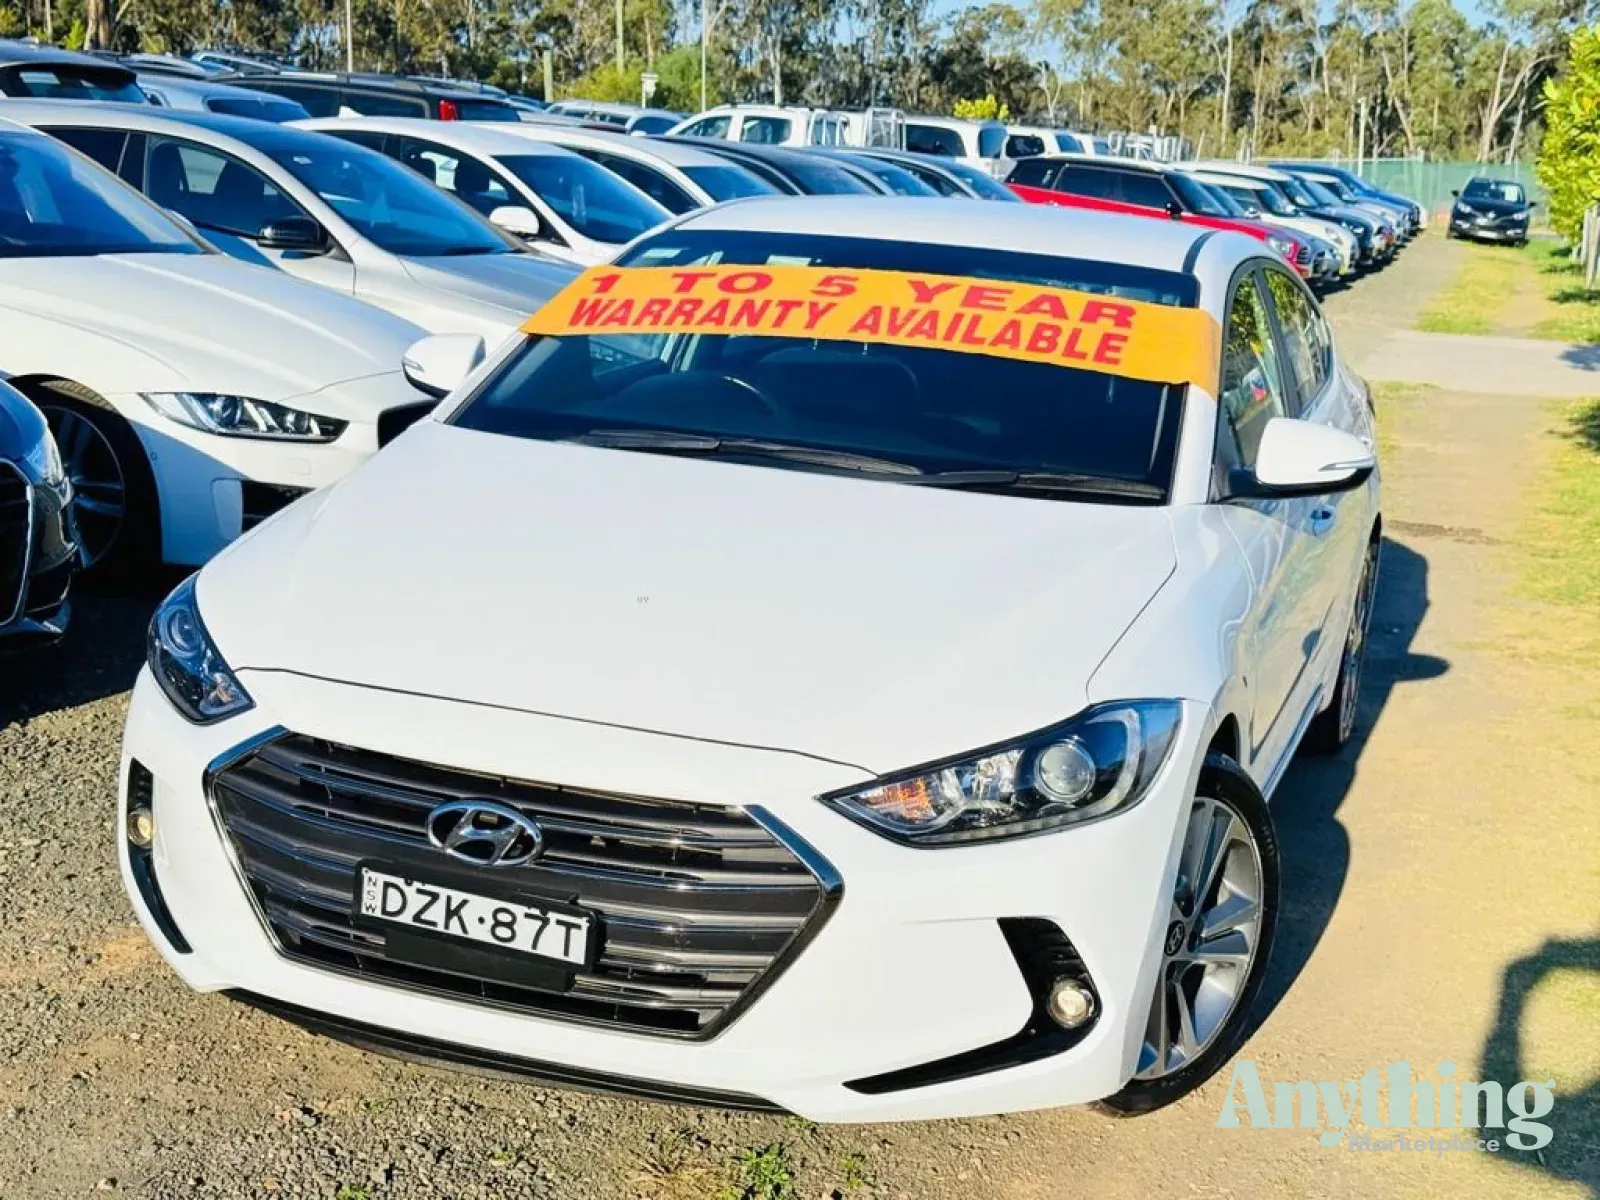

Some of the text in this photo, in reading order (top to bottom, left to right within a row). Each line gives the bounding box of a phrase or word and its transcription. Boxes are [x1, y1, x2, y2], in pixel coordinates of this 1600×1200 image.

[591, 272, 1137, 329] 1 TO 5 YEAR
[568, 298, 1131, 366] WARRANTY AVAILABLE
[364, 875, 378, 914] NSW
